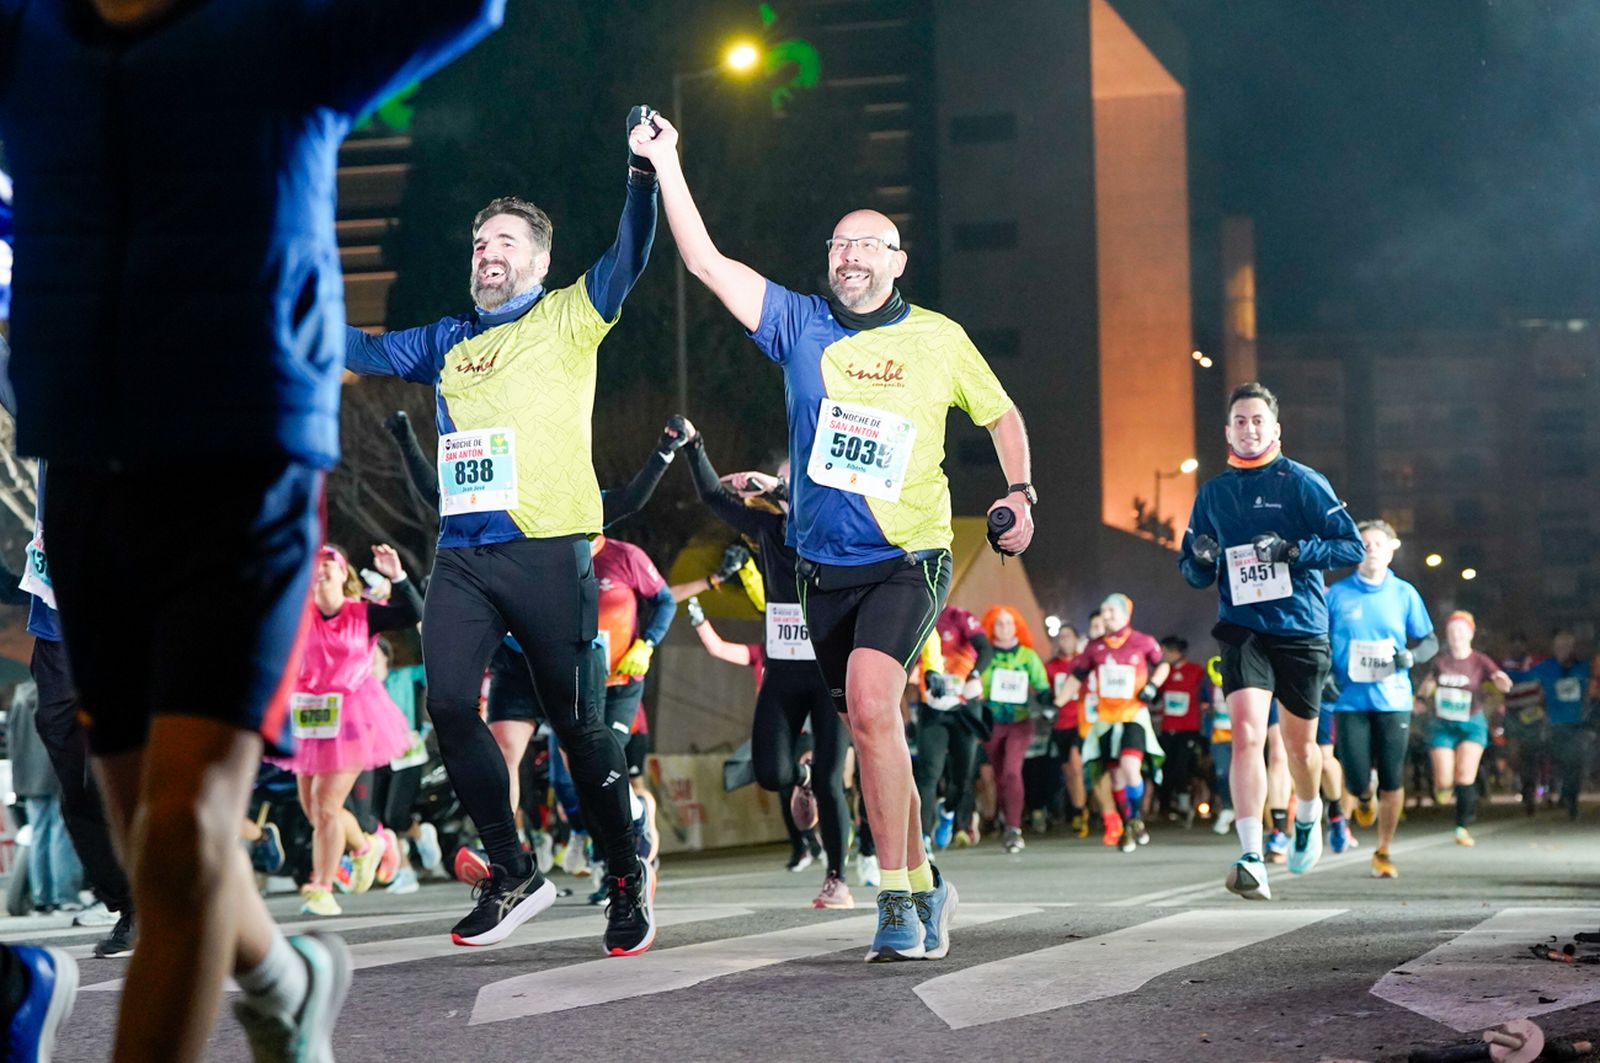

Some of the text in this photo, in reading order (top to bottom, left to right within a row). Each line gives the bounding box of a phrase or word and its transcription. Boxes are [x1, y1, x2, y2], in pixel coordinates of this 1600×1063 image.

[845, 359, 904, 382] inibé
[829, 420, 880, 439] SAN ANTON
[842, 412, 881, 428] NOCHE DE
[452, 438, 482, 450] NOCHE DE
[830, 432, 893, 469] 5035
[445, 451, 458, 462] SAN
[459, 449, 484, 459] ANTON
[455, 458, 494, 486] 838
[1240, 562, 1276, 584] 5451
[777, 624, 809, 640] 7076
